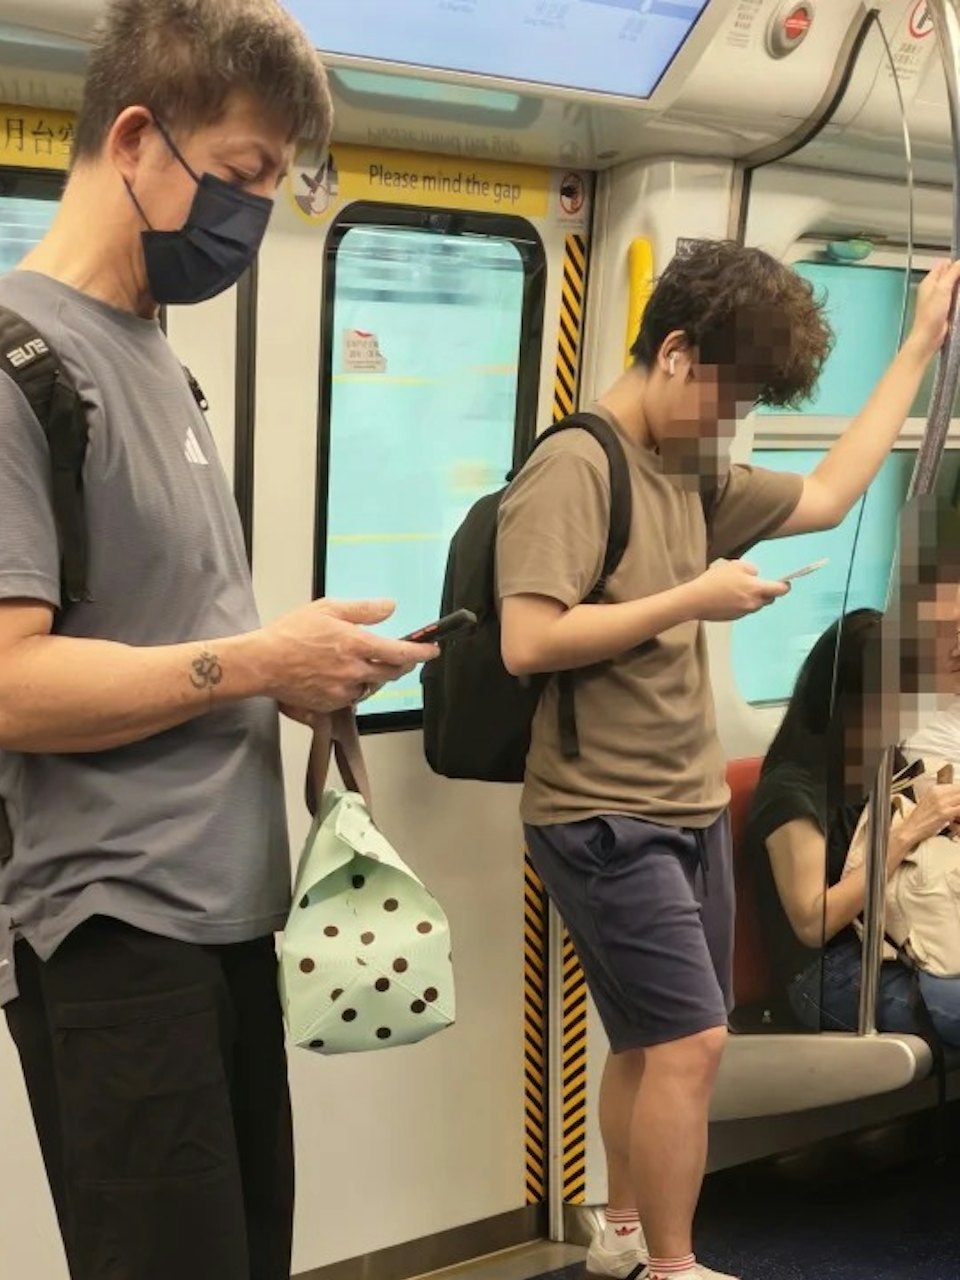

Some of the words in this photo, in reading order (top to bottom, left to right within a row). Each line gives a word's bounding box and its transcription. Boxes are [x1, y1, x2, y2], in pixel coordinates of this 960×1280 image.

[369, 165, 418, 188] Please
[422, 172, 461, 193] mind
[466, 174, 489, 196] the
[493, 182, 521, 204] gap
